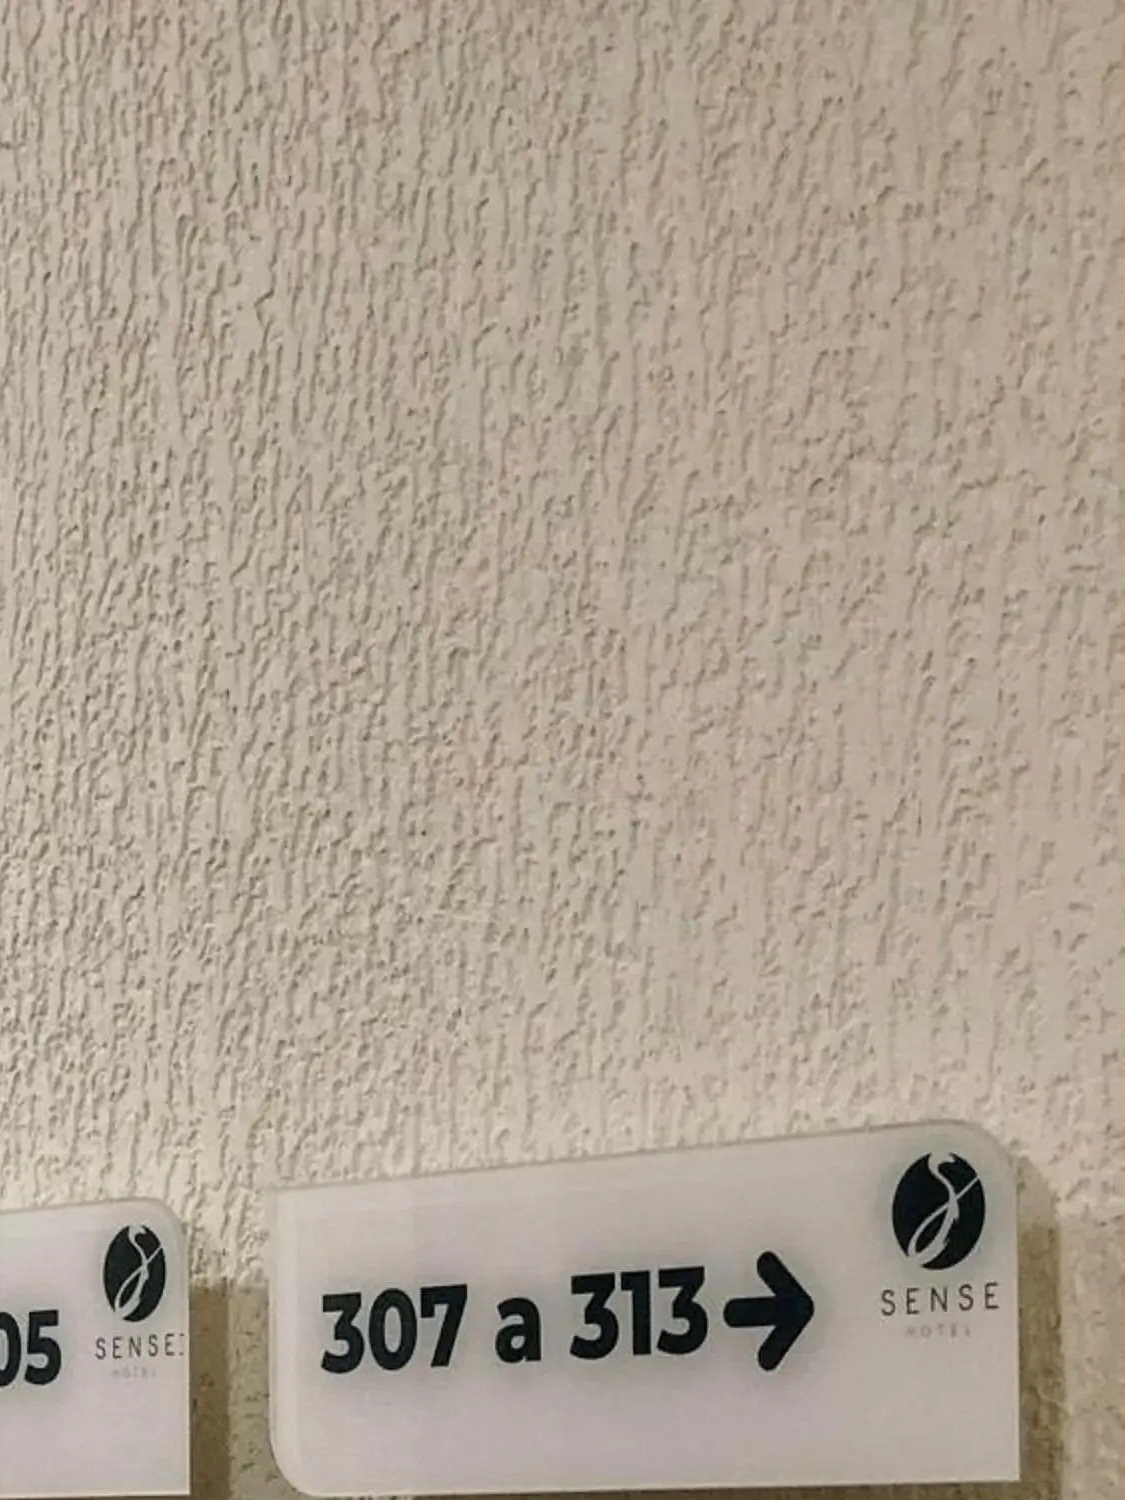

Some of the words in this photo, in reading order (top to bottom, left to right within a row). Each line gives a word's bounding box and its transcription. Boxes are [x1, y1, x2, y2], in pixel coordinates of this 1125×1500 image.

[320, 1283, 468, 1375] 307
[494, 1296, 542, 1365] a
[569, 1265, 710, 1361] 313
[880, 1281, 1001, 1317] SENSE
